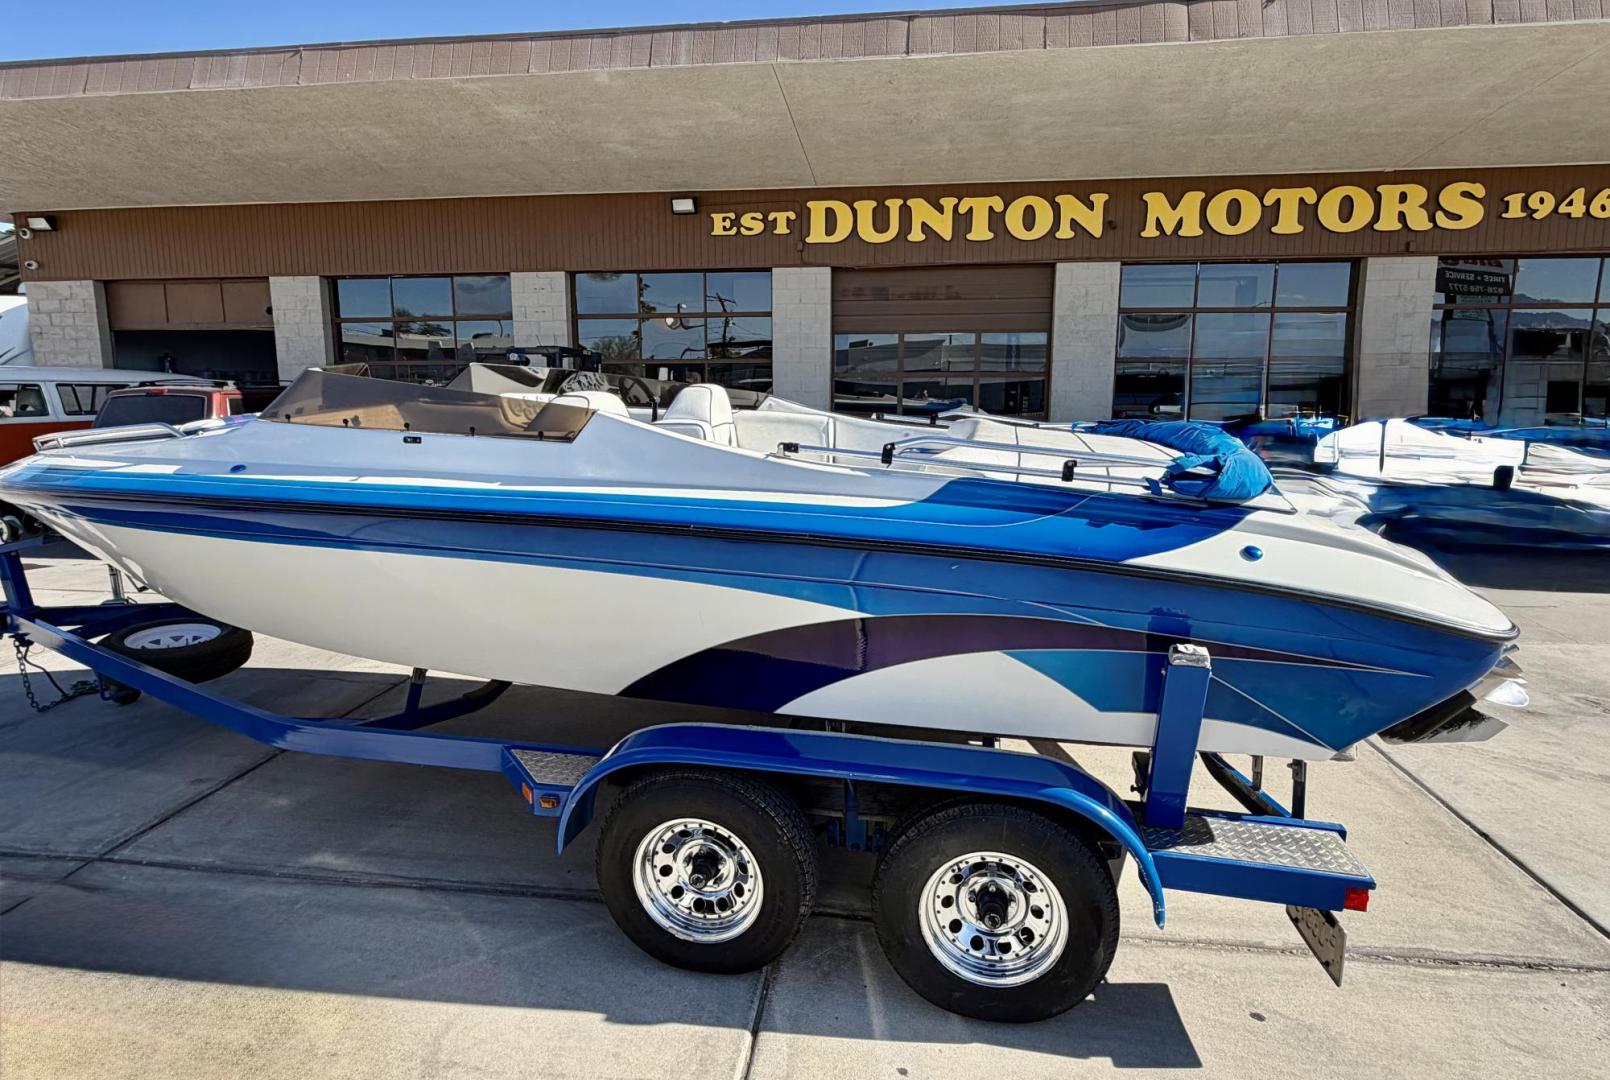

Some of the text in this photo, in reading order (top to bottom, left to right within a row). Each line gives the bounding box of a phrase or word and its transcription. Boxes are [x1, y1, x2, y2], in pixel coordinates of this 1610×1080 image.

[711, 181, 1610, 243] EST DUNTON MOTORS 1946
